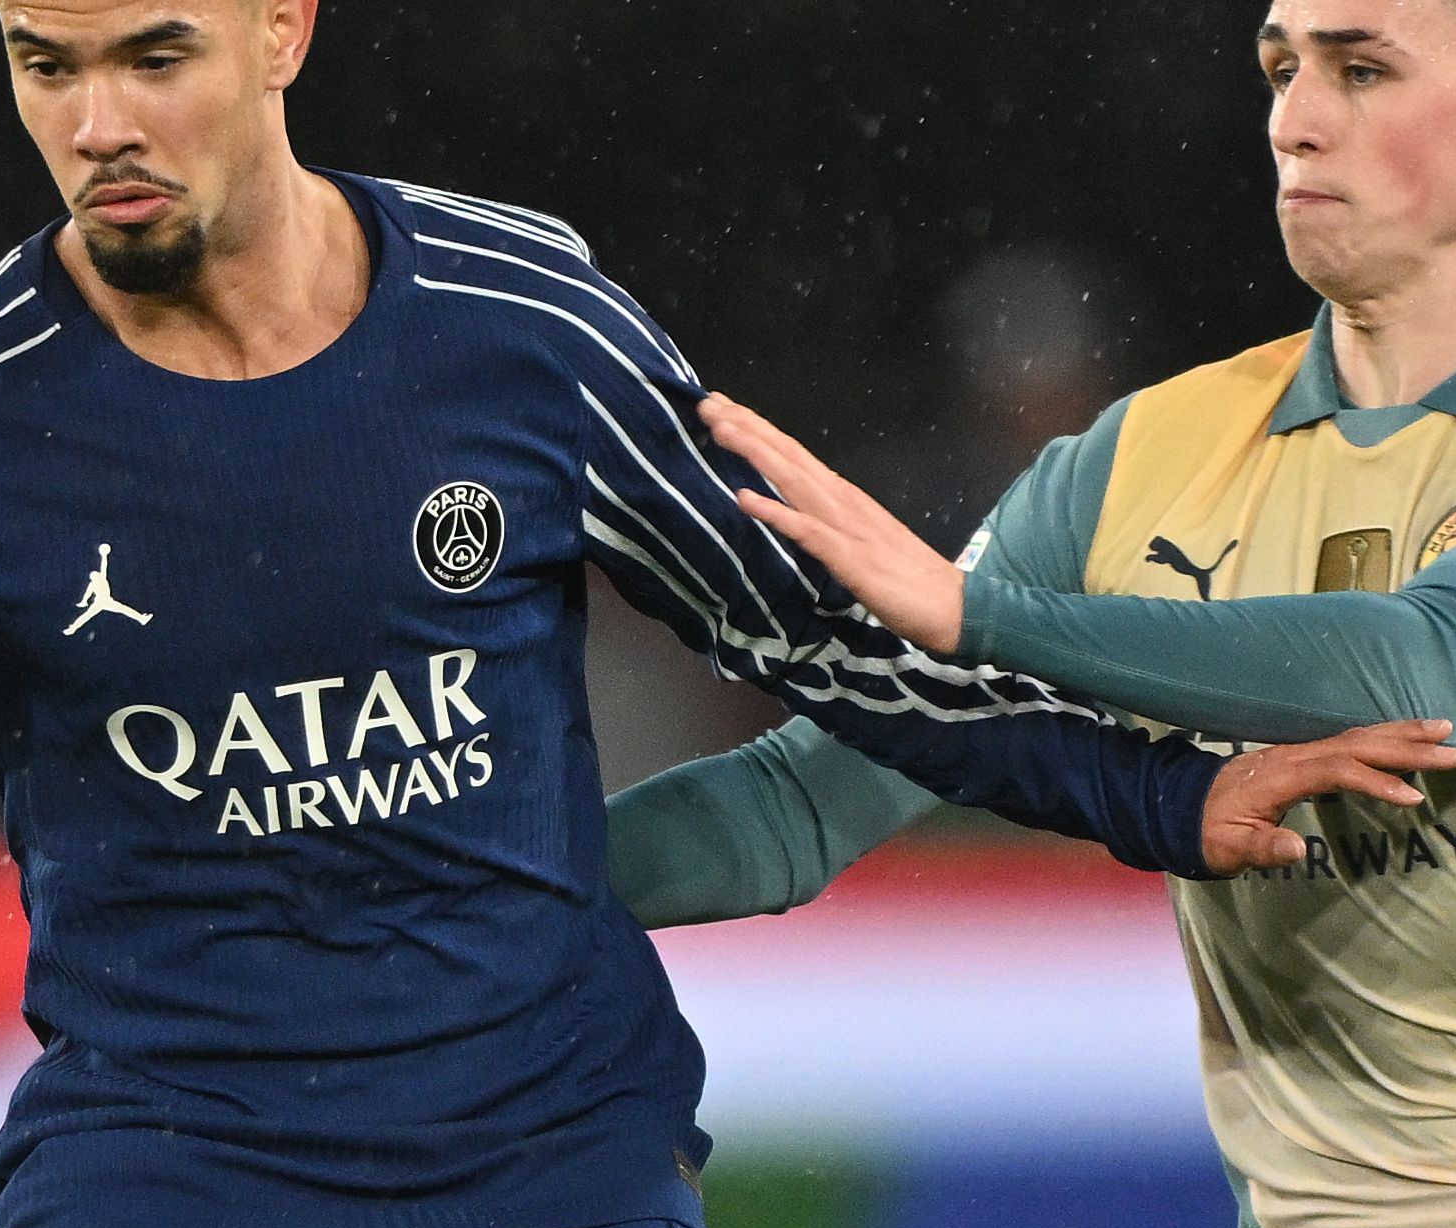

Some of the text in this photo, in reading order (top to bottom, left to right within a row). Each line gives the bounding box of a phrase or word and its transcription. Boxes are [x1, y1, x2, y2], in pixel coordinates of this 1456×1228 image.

[426, 487, 489, 518] PARIS
[106, 648, 487, 802] QATAR
[217, 733, 494, 836] AIRWAYS
